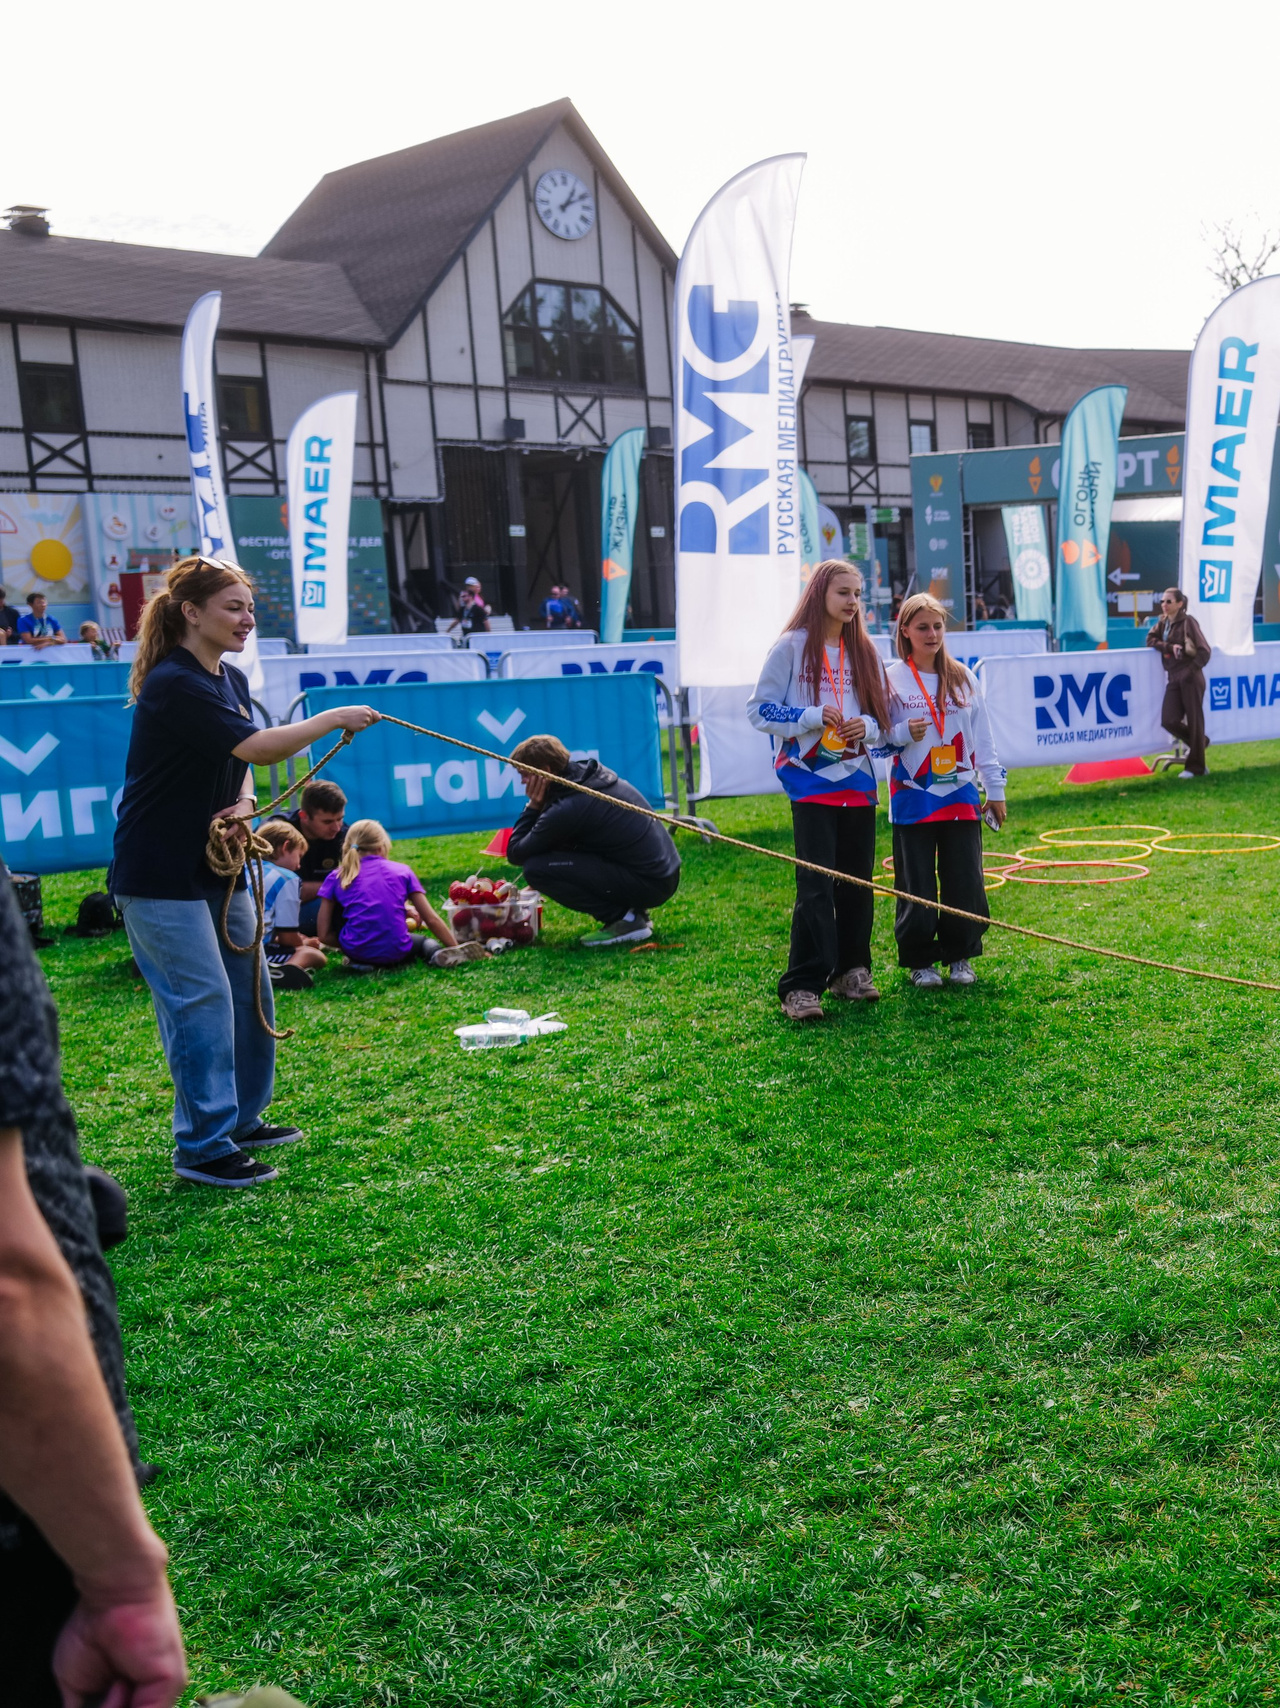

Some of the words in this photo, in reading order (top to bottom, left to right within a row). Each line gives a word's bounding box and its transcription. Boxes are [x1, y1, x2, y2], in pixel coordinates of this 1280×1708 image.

[680, 285, 770, 555] RMG
[1201, 336, 1260, 547] MAER
[304, 435, 333, 571] MAER
[777, 459, 795, 555] РУССКАЯ
[1033, 672, 1132, 730] RMG
[1036, 731, 1075, 746] РУССКАЯ
[1076, 726, 1133, 743] МЕДИАГРУППА
